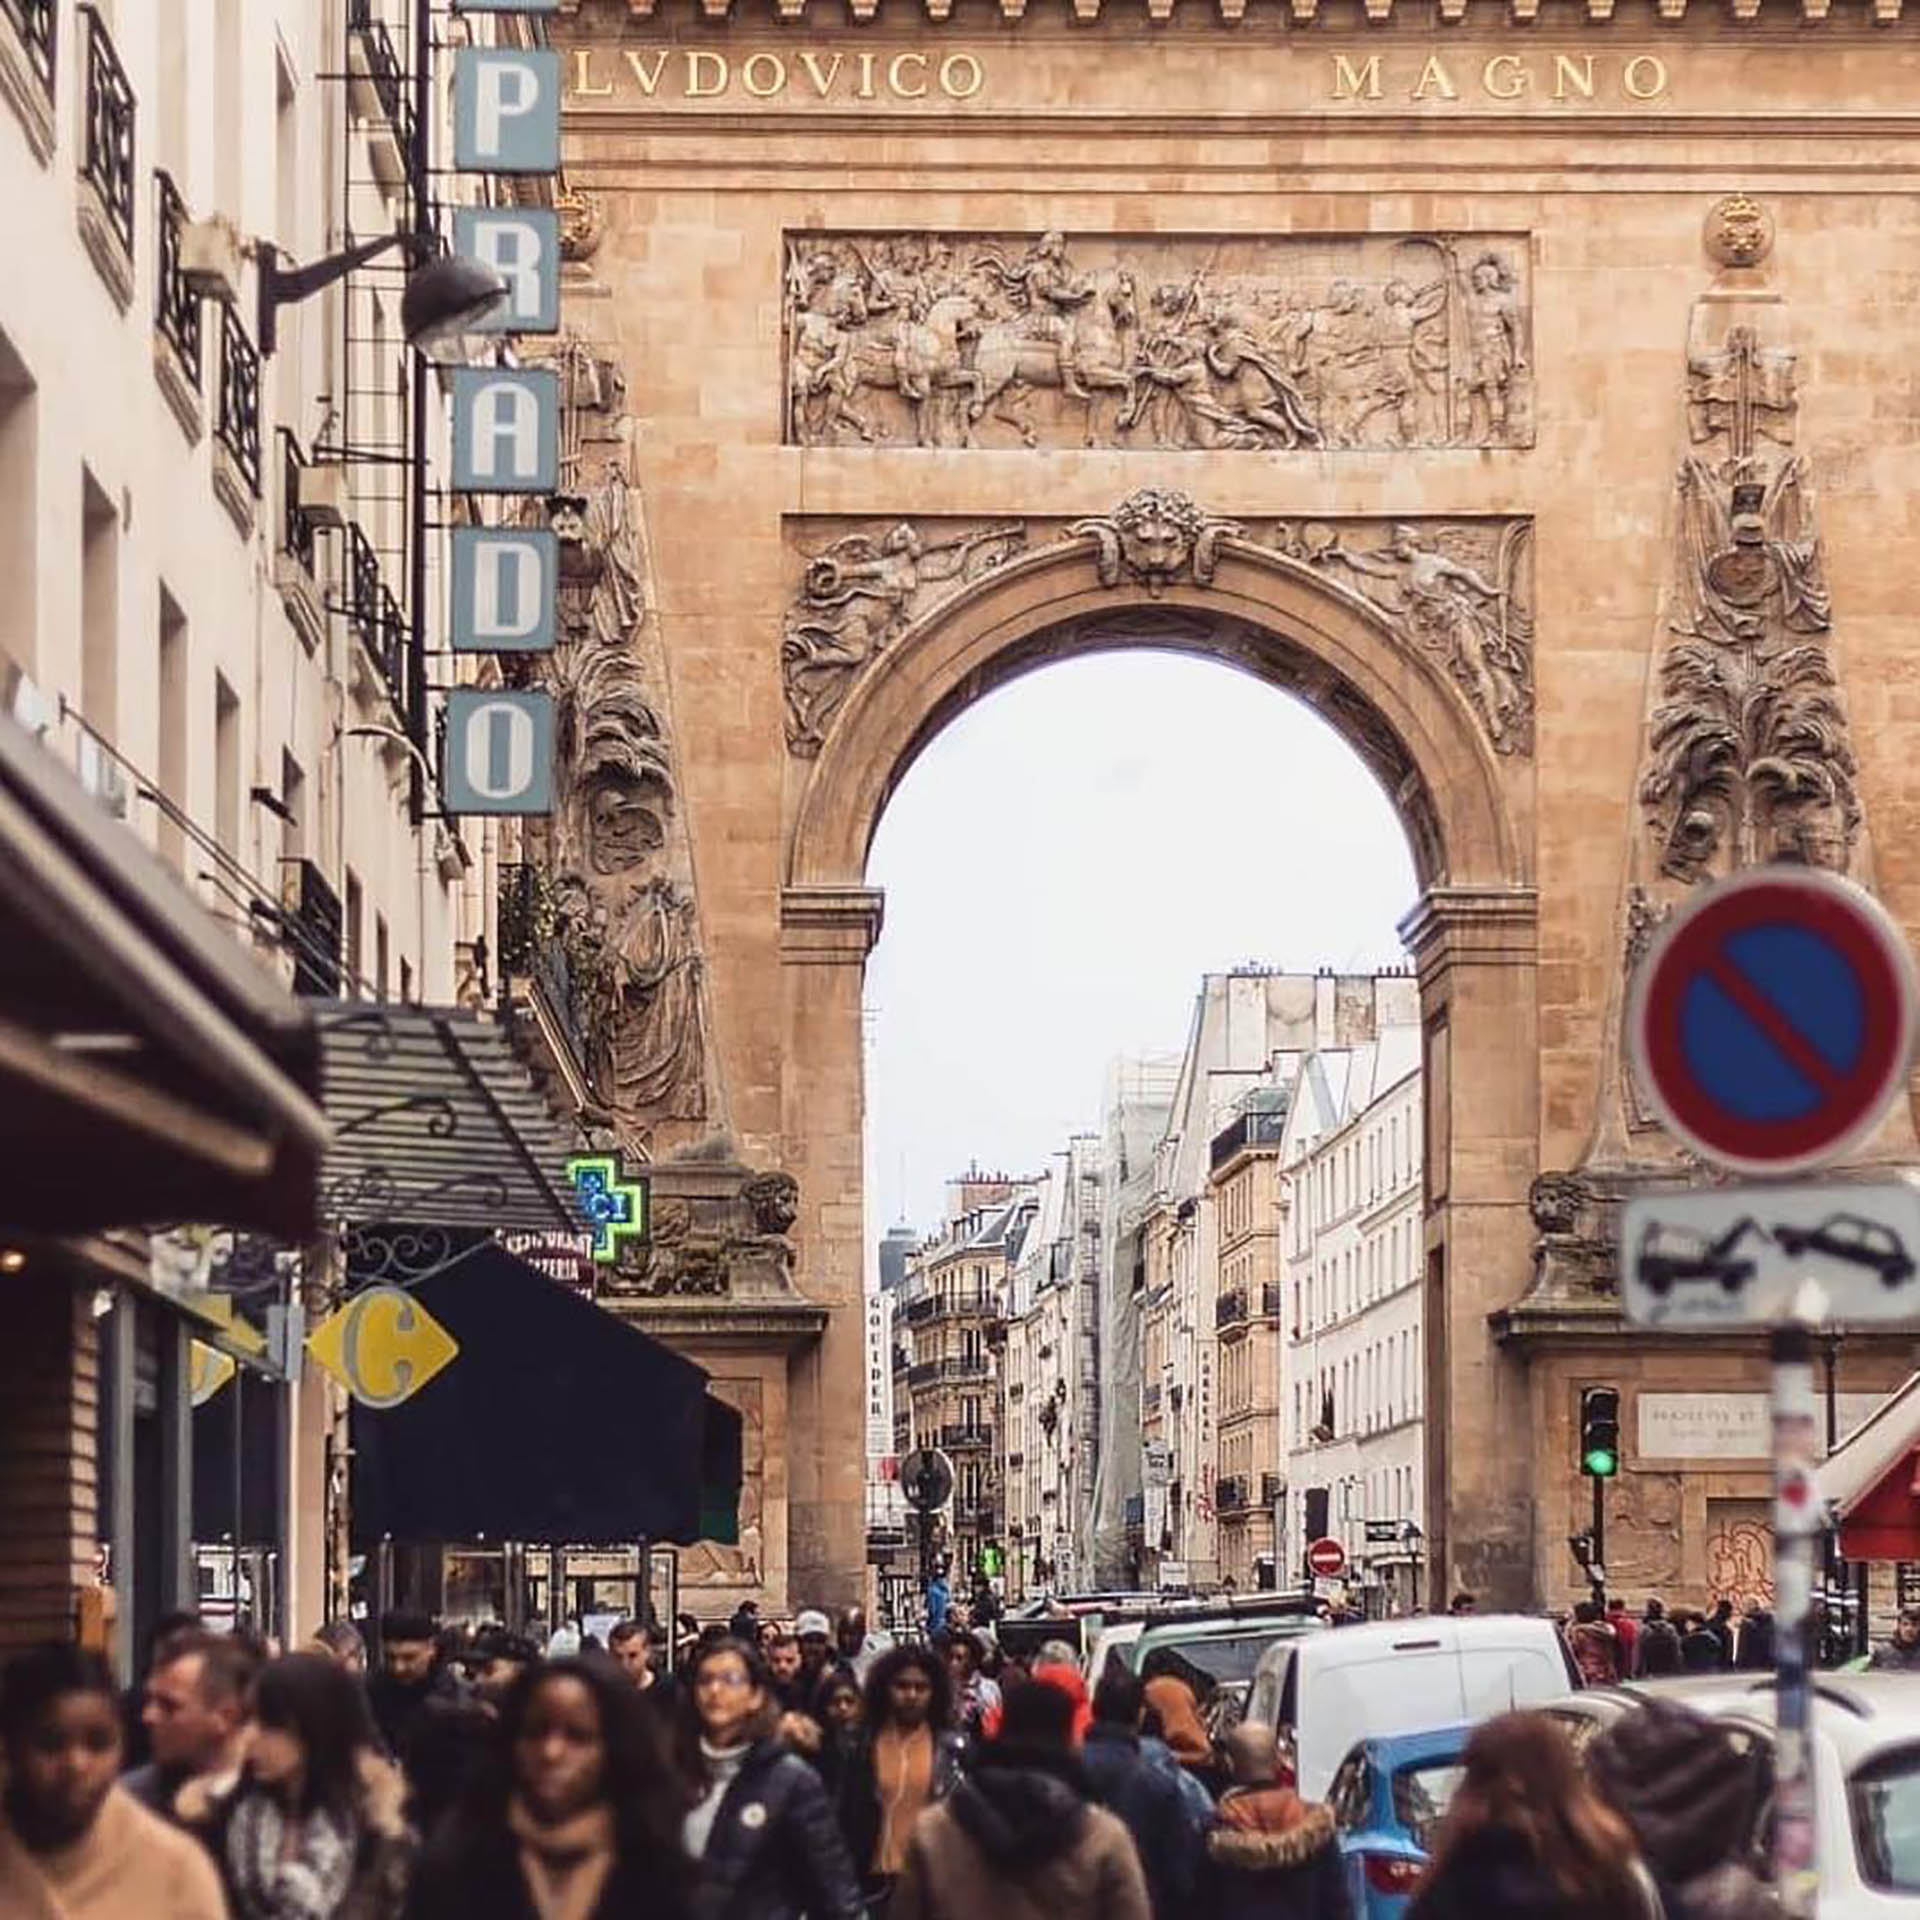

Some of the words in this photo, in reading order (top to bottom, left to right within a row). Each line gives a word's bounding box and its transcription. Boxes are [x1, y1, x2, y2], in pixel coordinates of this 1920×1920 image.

[573, 50, 984, 98] LVDOVICO
[1331, 54, 1668, 99] MAGNO
[466, 61, 544, 799] PRADO
